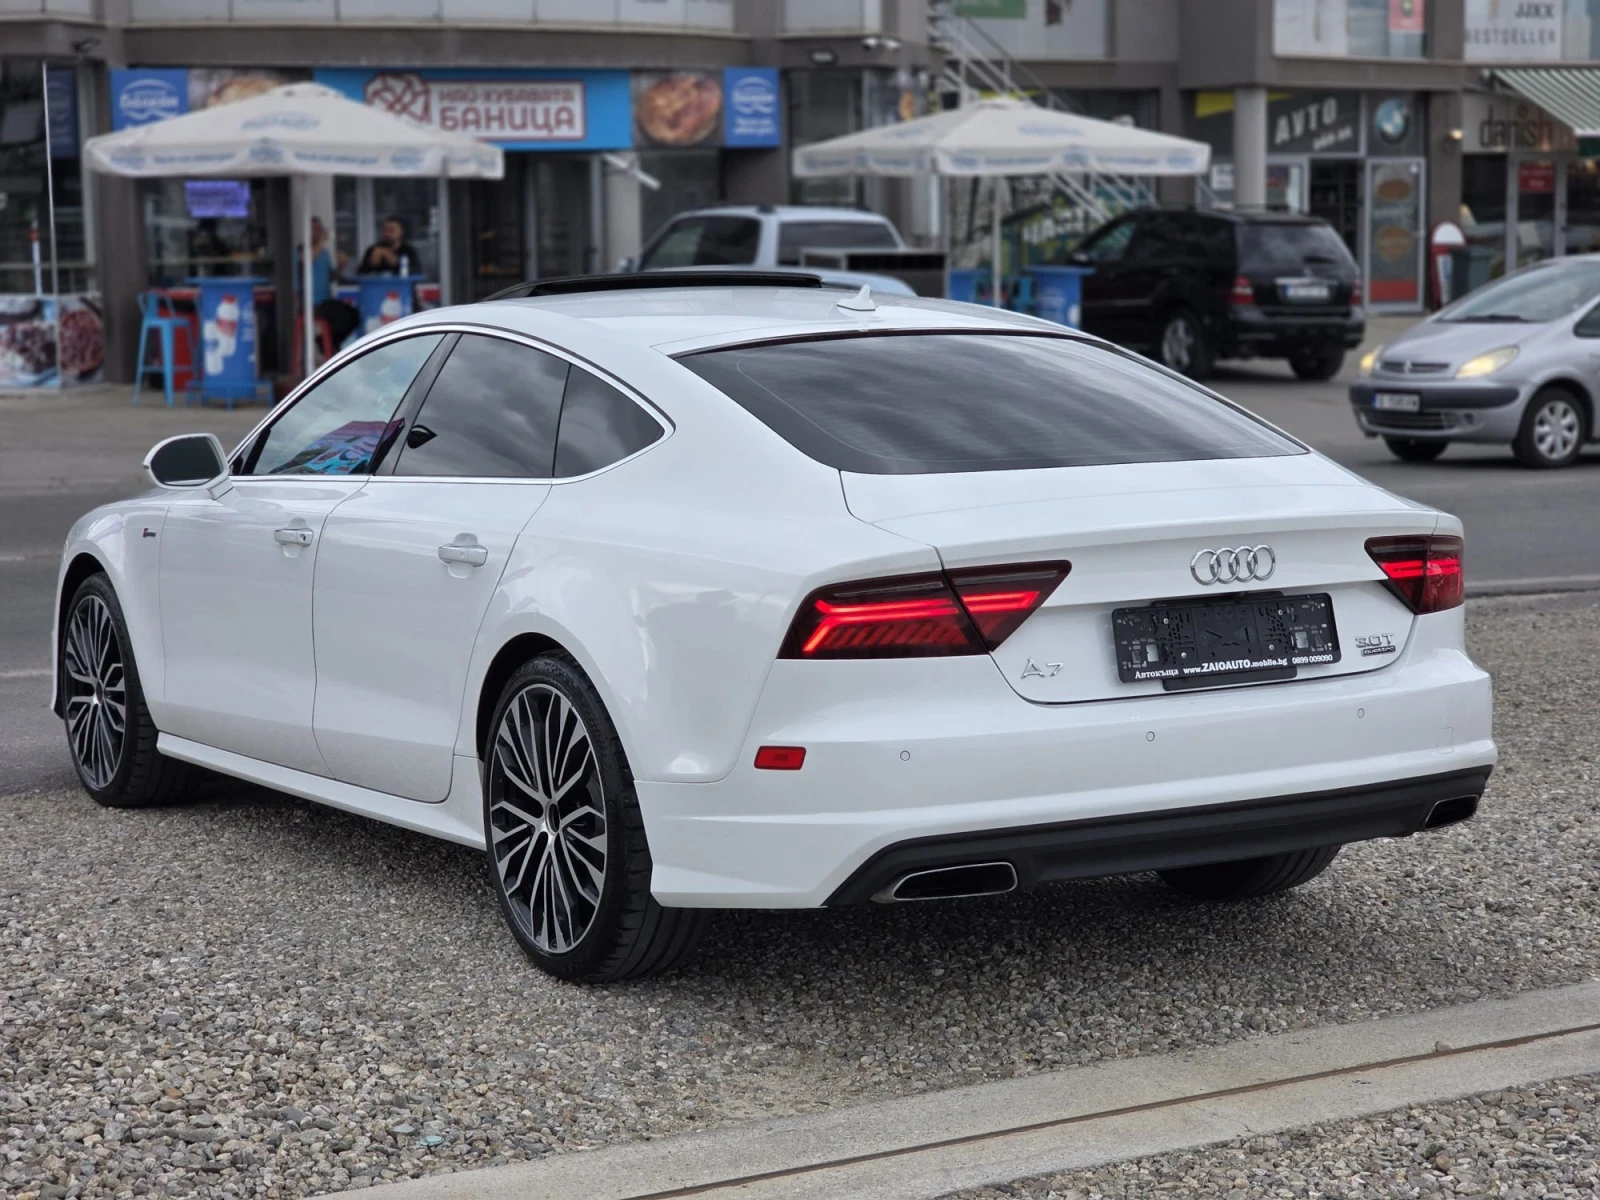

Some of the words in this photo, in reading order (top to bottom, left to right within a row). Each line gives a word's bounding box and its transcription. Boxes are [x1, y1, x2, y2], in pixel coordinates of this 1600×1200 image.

[439, 105, 575, 136] БАНИЦА
[1363, 645, 1396, 656] quattro
[1020, 658, 1064, 679] A7
[1134, 667, 1179, 680] Автокъща
[1292, 655, 1308, 665] 0899
[1309, 653, 1333, 664] 009090
